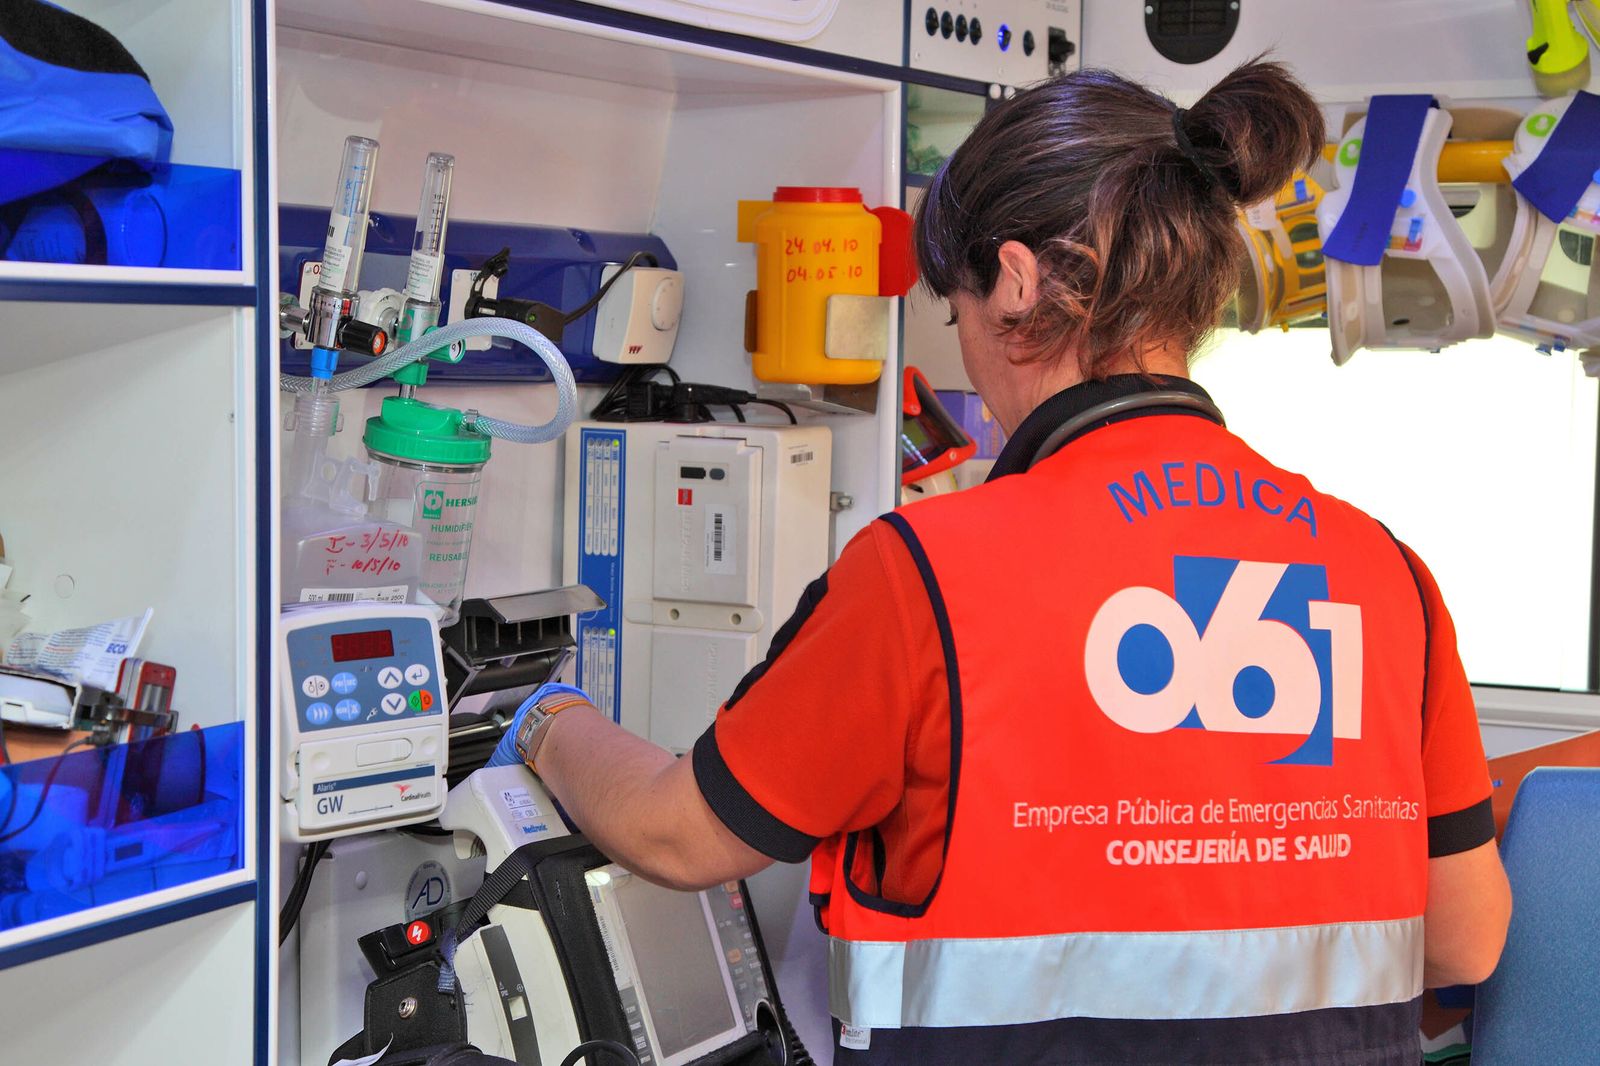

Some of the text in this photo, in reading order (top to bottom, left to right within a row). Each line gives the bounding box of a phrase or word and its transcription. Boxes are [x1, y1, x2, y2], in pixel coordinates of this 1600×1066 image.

[1107, 461, 1318, 538] MEDICA
[1084, 559, 1364, 740] 061
[316, 795, 344, 815] GW
[1013, 793, 1420, 832] Empresa Pública de Emergencias Sanitarias
[1105, 831, 1352, 866] CONSEJERÍA DE SALUD
